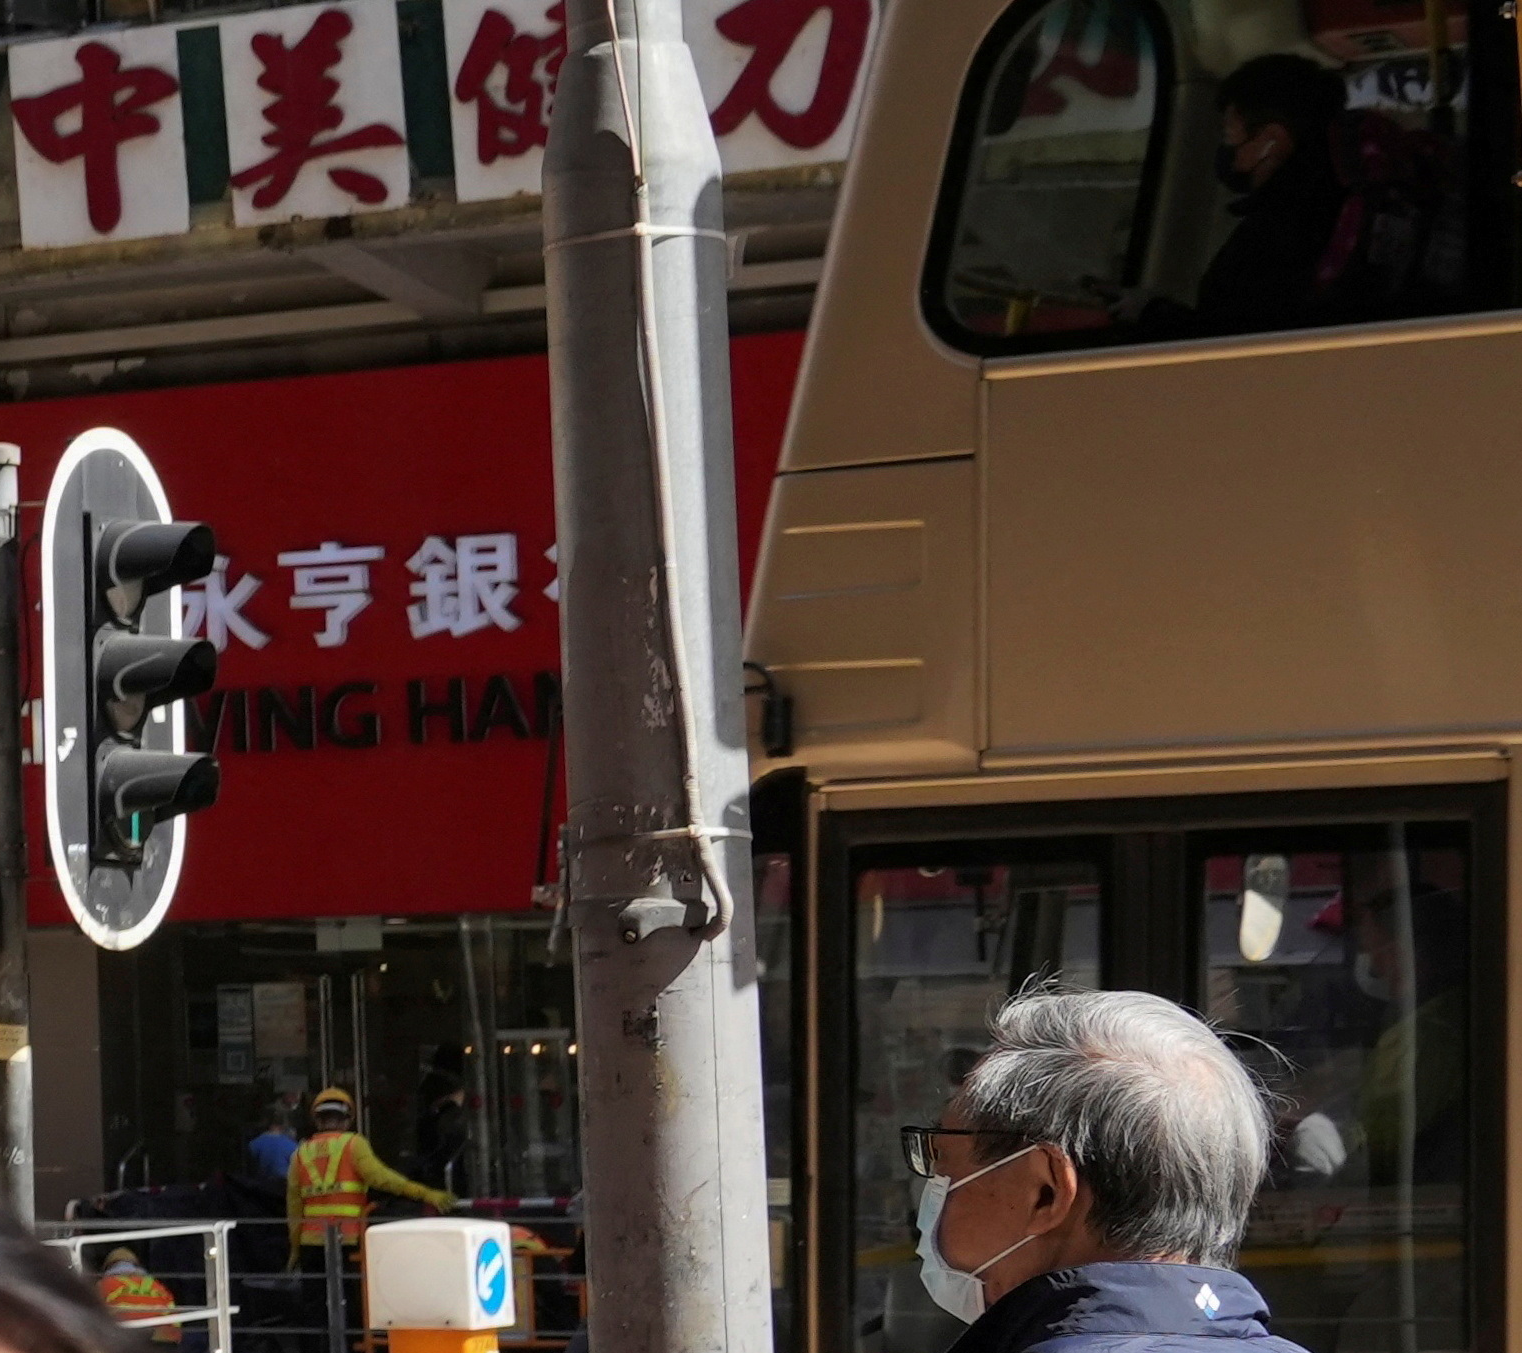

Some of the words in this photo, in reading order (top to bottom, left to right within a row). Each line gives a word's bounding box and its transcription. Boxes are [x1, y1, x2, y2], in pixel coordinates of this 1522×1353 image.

[182, 534, 559, 651] 永亨銀
[409, 670, 562, 746] HA
